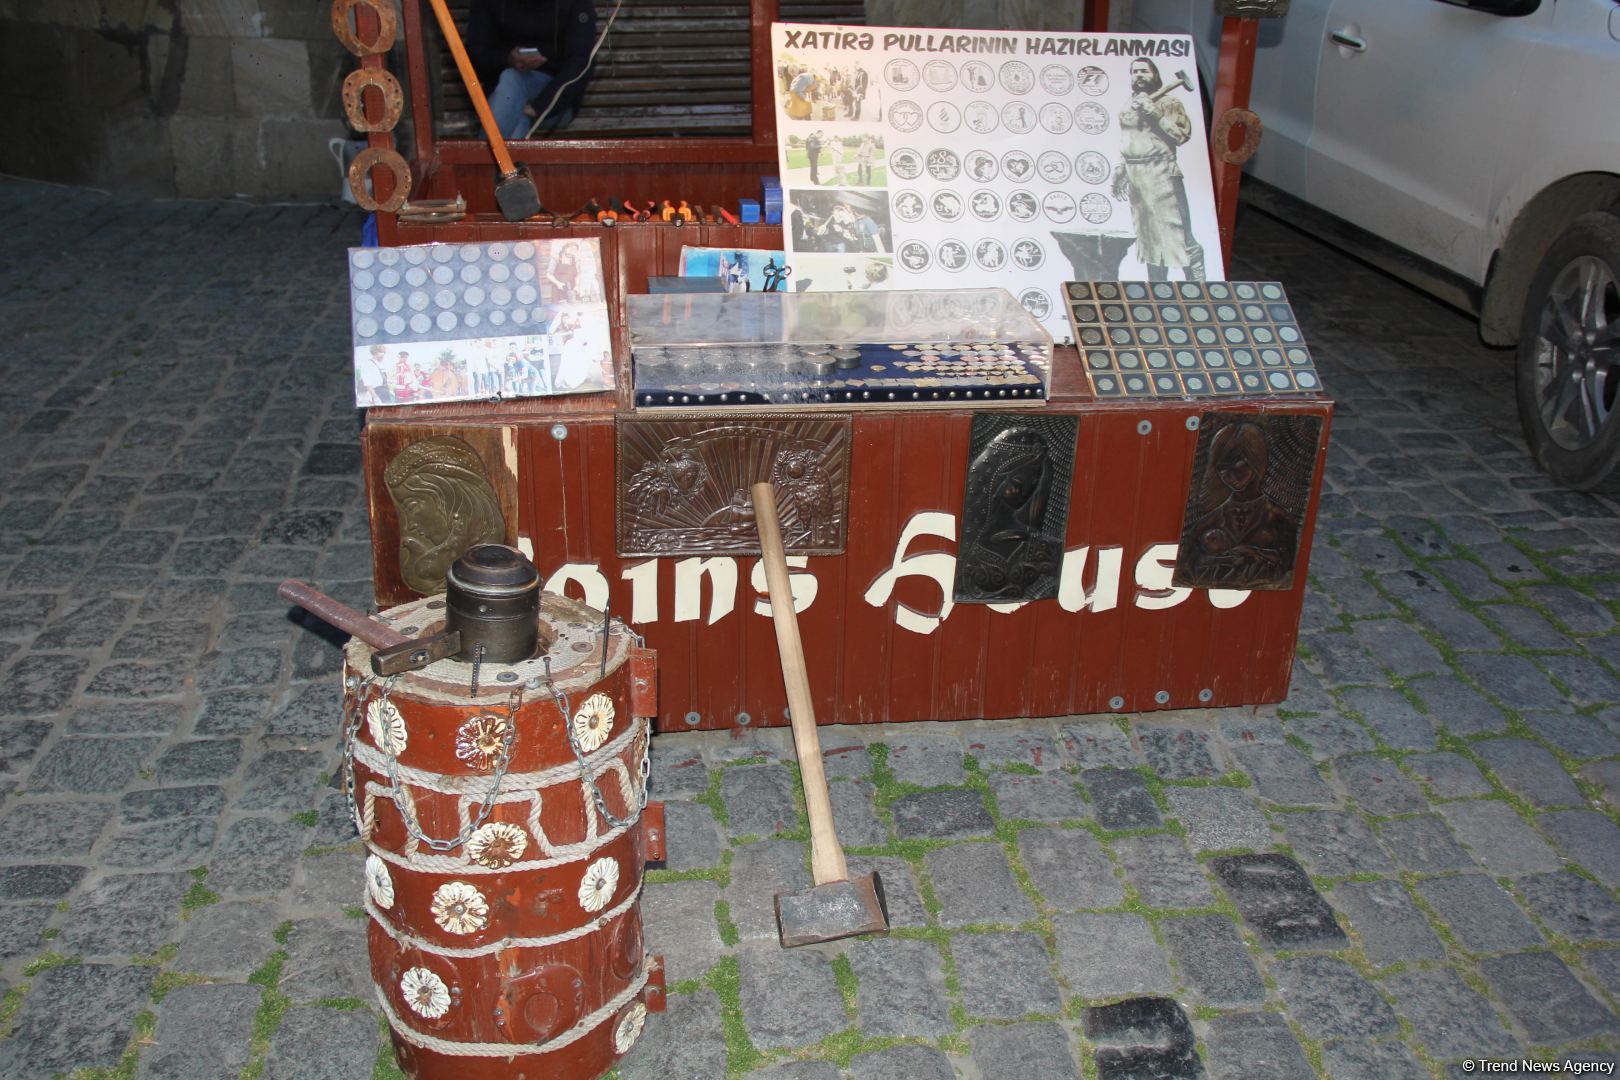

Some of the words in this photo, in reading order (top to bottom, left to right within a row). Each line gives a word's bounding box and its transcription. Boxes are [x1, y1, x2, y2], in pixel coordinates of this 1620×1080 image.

[784, 27, 874, 50] XATİRƏ
[883, 33, 1018, 54] PULLARININ
[1025, 37, 1191, 57] HAZIRLANMASI
[517, 537, 818, 625] oins
[864, 512, 1252, 634] Hus
